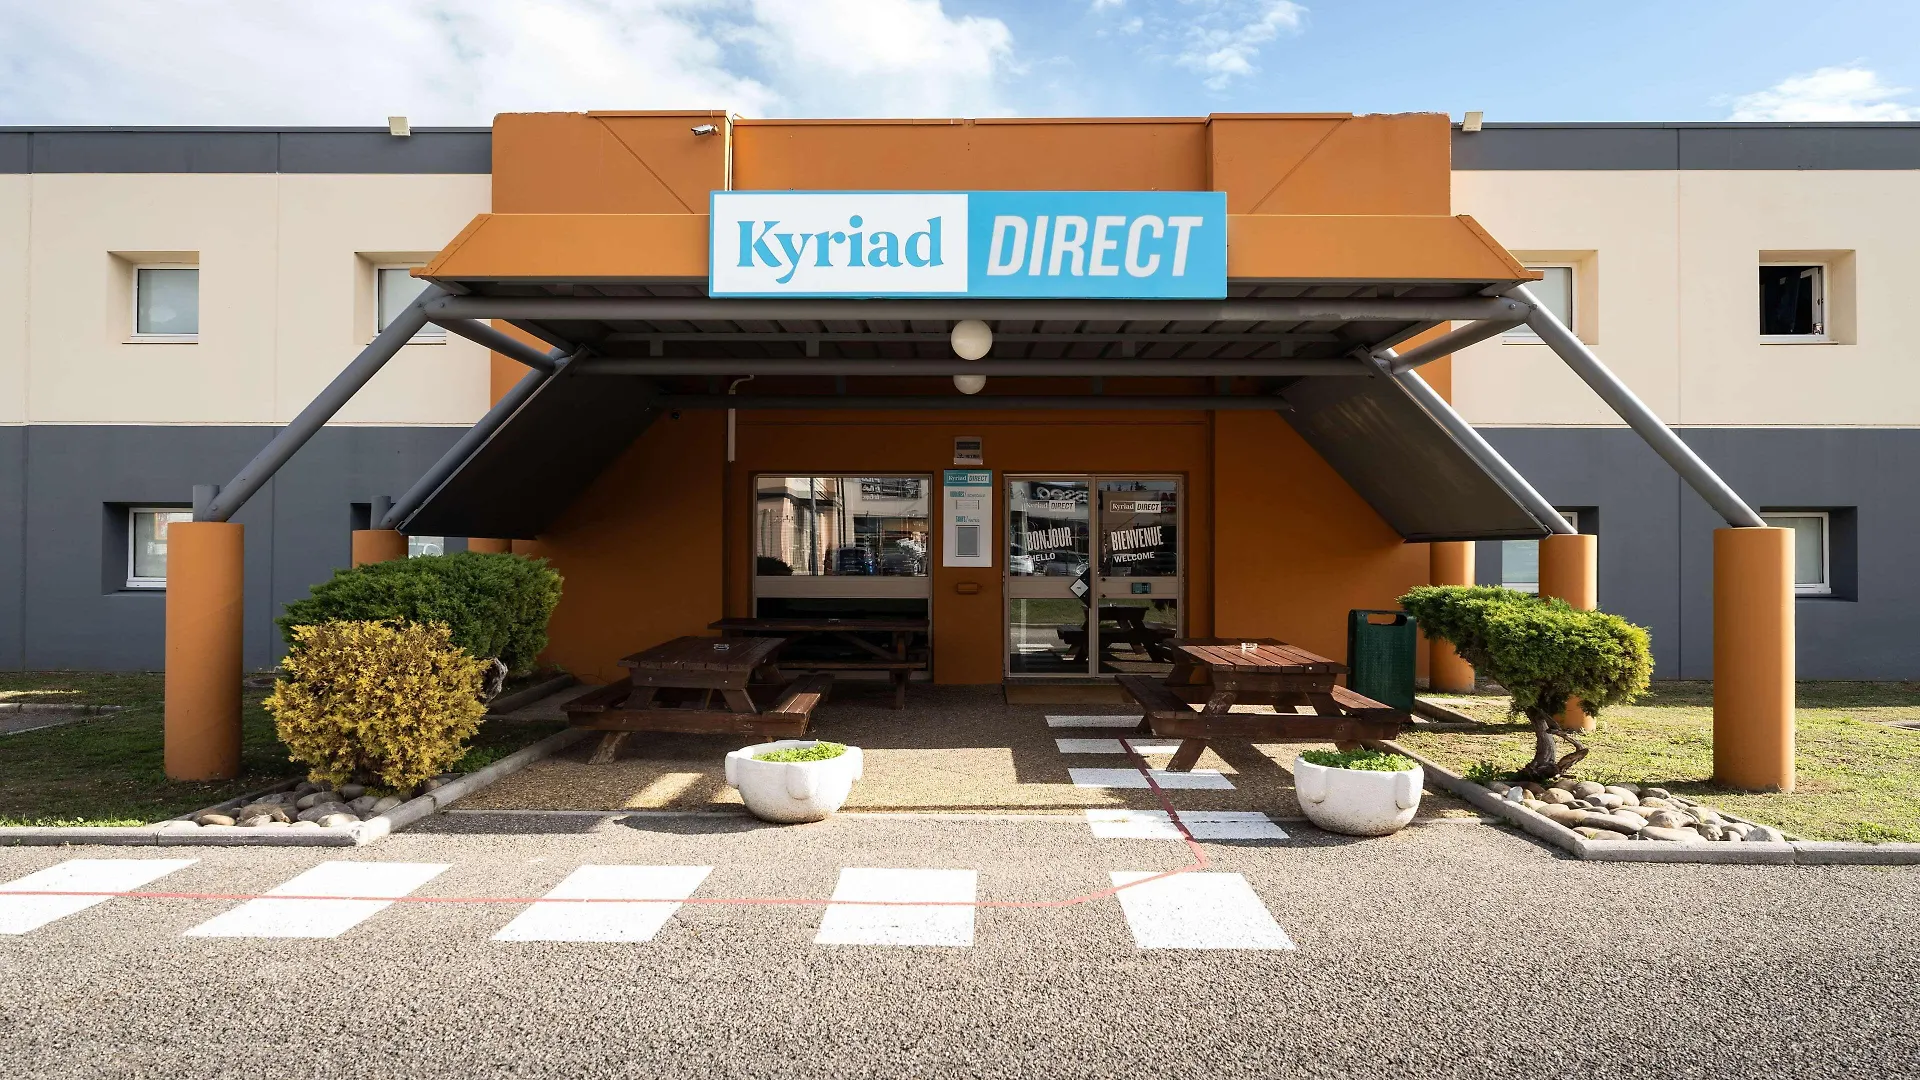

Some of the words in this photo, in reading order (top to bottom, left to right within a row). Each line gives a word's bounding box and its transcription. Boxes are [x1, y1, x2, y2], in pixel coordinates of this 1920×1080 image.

[737, 214, 944, 284] Kyriad
[986, 215, 1204, 278] DIRECT
[1050, 502, 1074, 510] DIRECT
[1112, 502, 1134, 511] Kyriad
[1137, 503, 1160, 511] DIRECT
[1026, 526, 1073, 552] BONJOUR
[1110, 525, 1164, 552] BIENVENUE
[1030, 552, 1056, 563] HELLO
[1113, 551, 1155, 563] WELCOME
